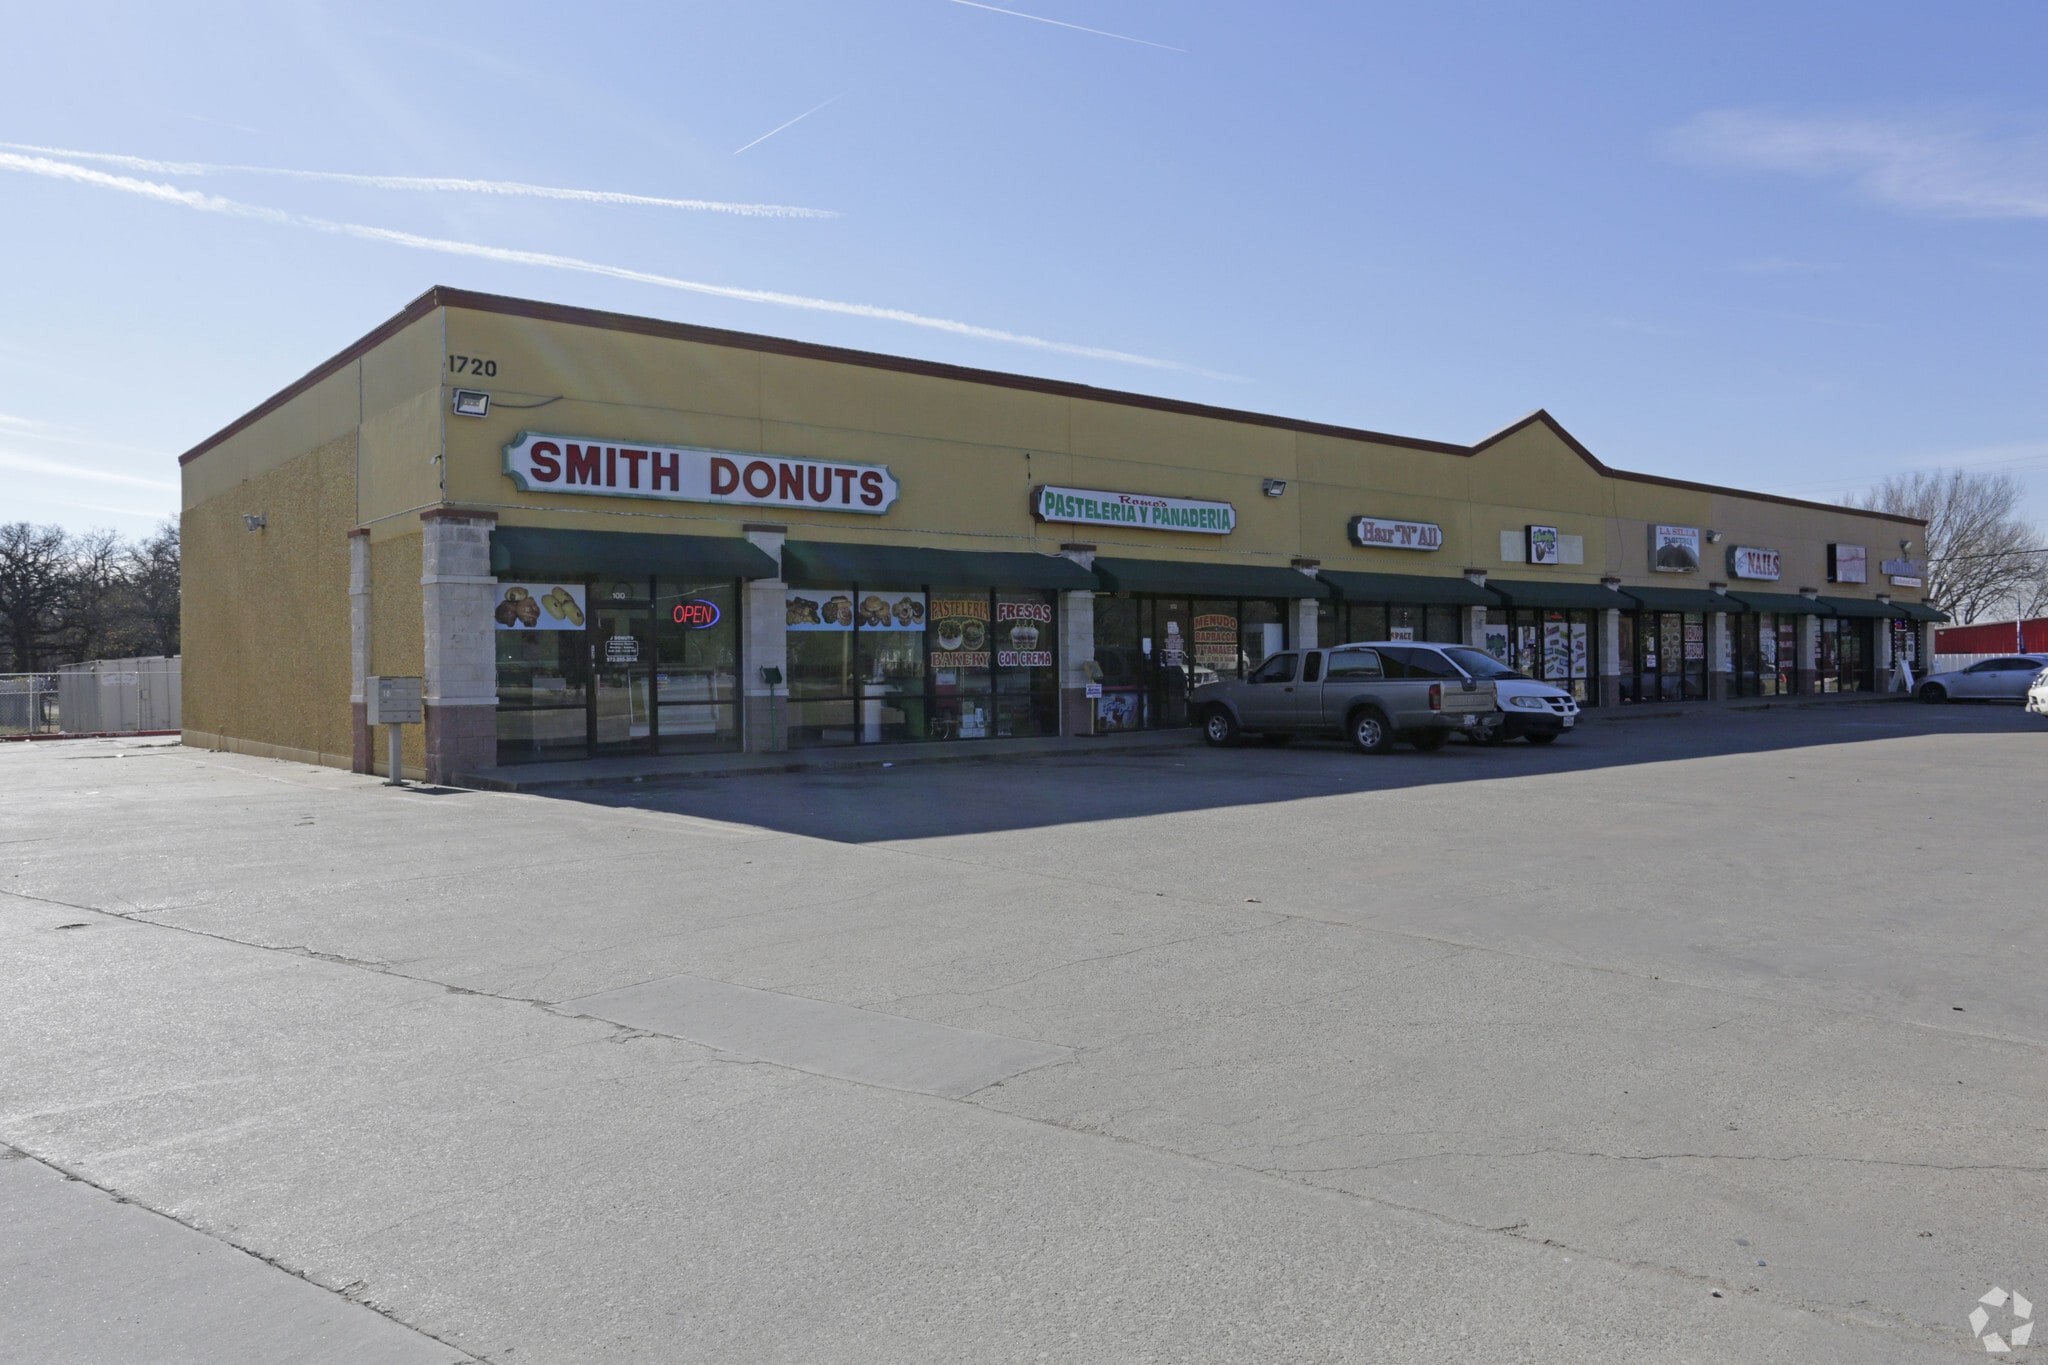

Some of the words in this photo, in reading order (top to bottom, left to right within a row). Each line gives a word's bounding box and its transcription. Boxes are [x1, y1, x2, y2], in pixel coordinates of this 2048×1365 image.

[448, 354, 498, 378] 1720
[530, 441, 680, 492] SMITH
[710, 457, 884, 506] DONUTS
[1044, 491, 1136, 523] PASTELERIA
[1138, 506, 1149, 524] Y
[1152, 507, 1231, 530] PANADERIA
[1362, 521, 1394, 544] Hair
[1418, 526, 1438, 547] All
[1659, 527, 1671, 536] LA
[1747, 551, 1780, 576] NAILS
[612, 592, 626, 600] 100
[673, 605, 713, 624] OPEN
[930, 600, 991, 621] PASTELERIA
[997, 603, 1052, 623] FRESAS
[1194, 614, 1238, 630] MENUDO
[1194, 631, 1238, 643] BARBACOA
[997, 651, 1019, 667] CON
[1020, 651, 1052, 667] CREMA
[1202, 644, 1238, 655] TAMALES
[930, 651, 991, 668] BAKERY
